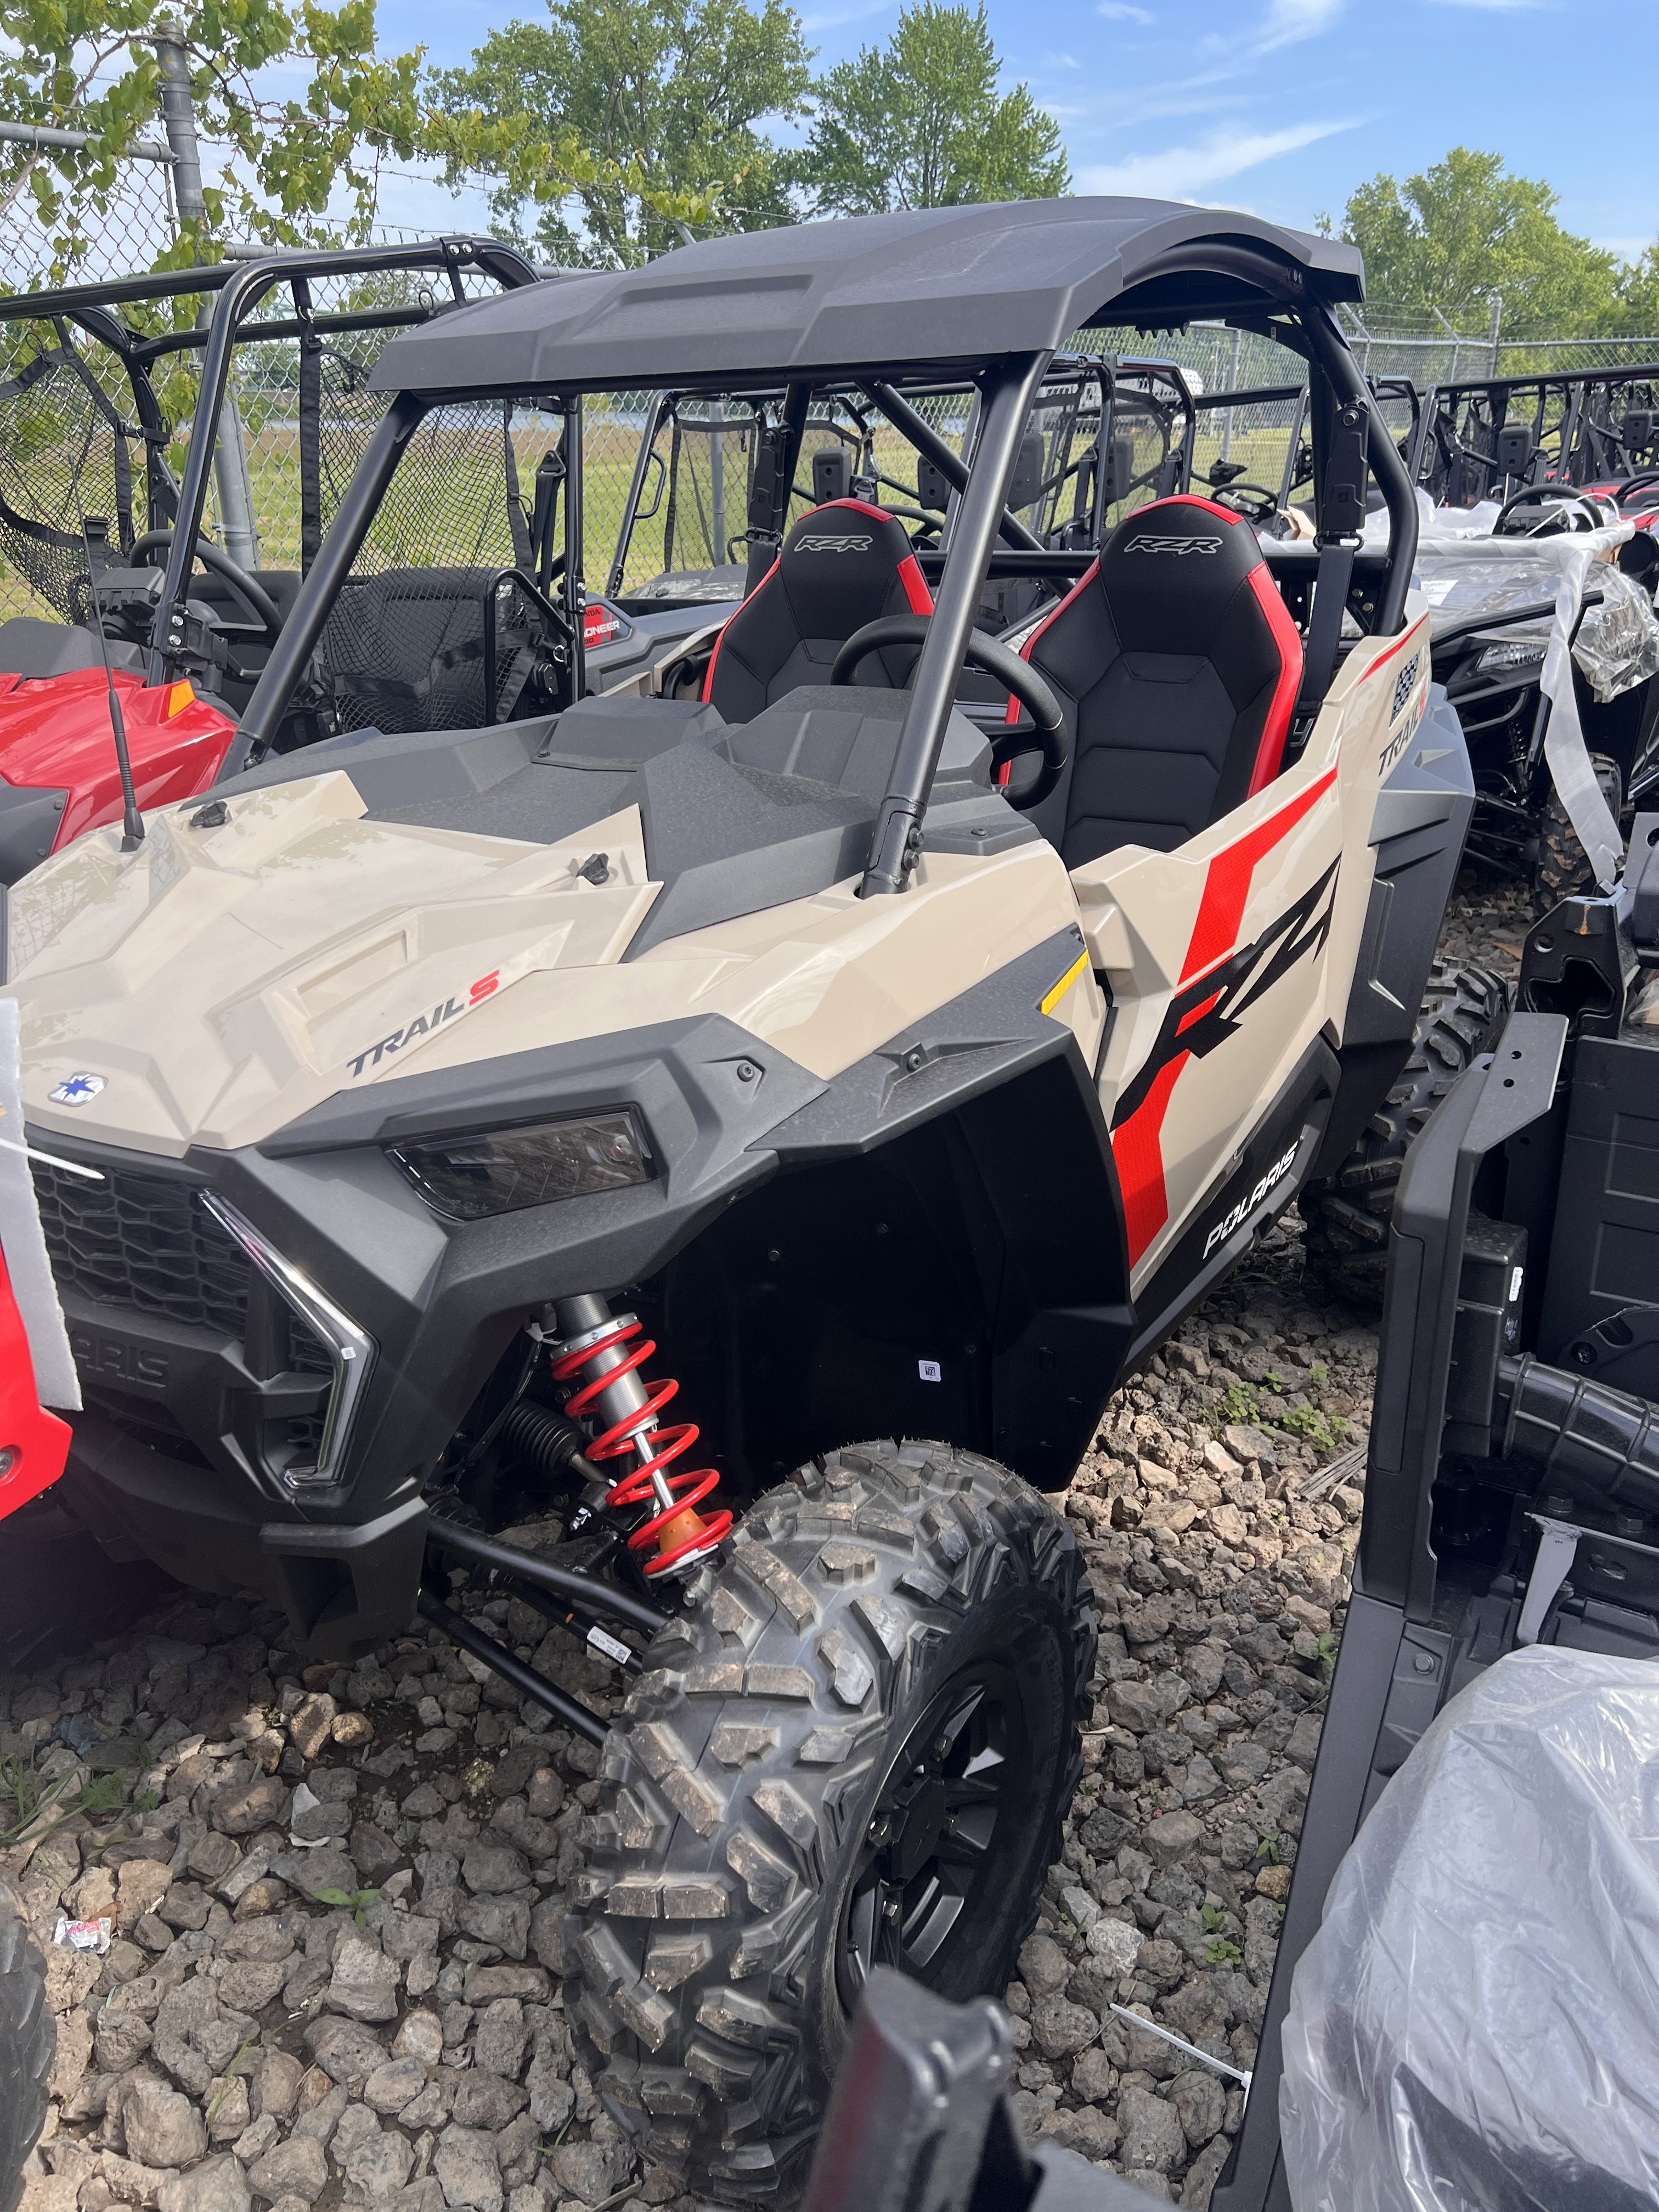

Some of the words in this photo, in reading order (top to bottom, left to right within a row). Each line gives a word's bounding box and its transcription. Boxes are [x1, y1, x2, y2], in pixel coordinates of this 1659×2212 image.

[794, 535, 873, 553] RZR
[1124, 535, 1223, 555] RZR
[585, 609, 600, 617] NDA
[1203, 1141, 1299, 1260] POLARIS
[71, 1330, 170, 1389] ARIS
